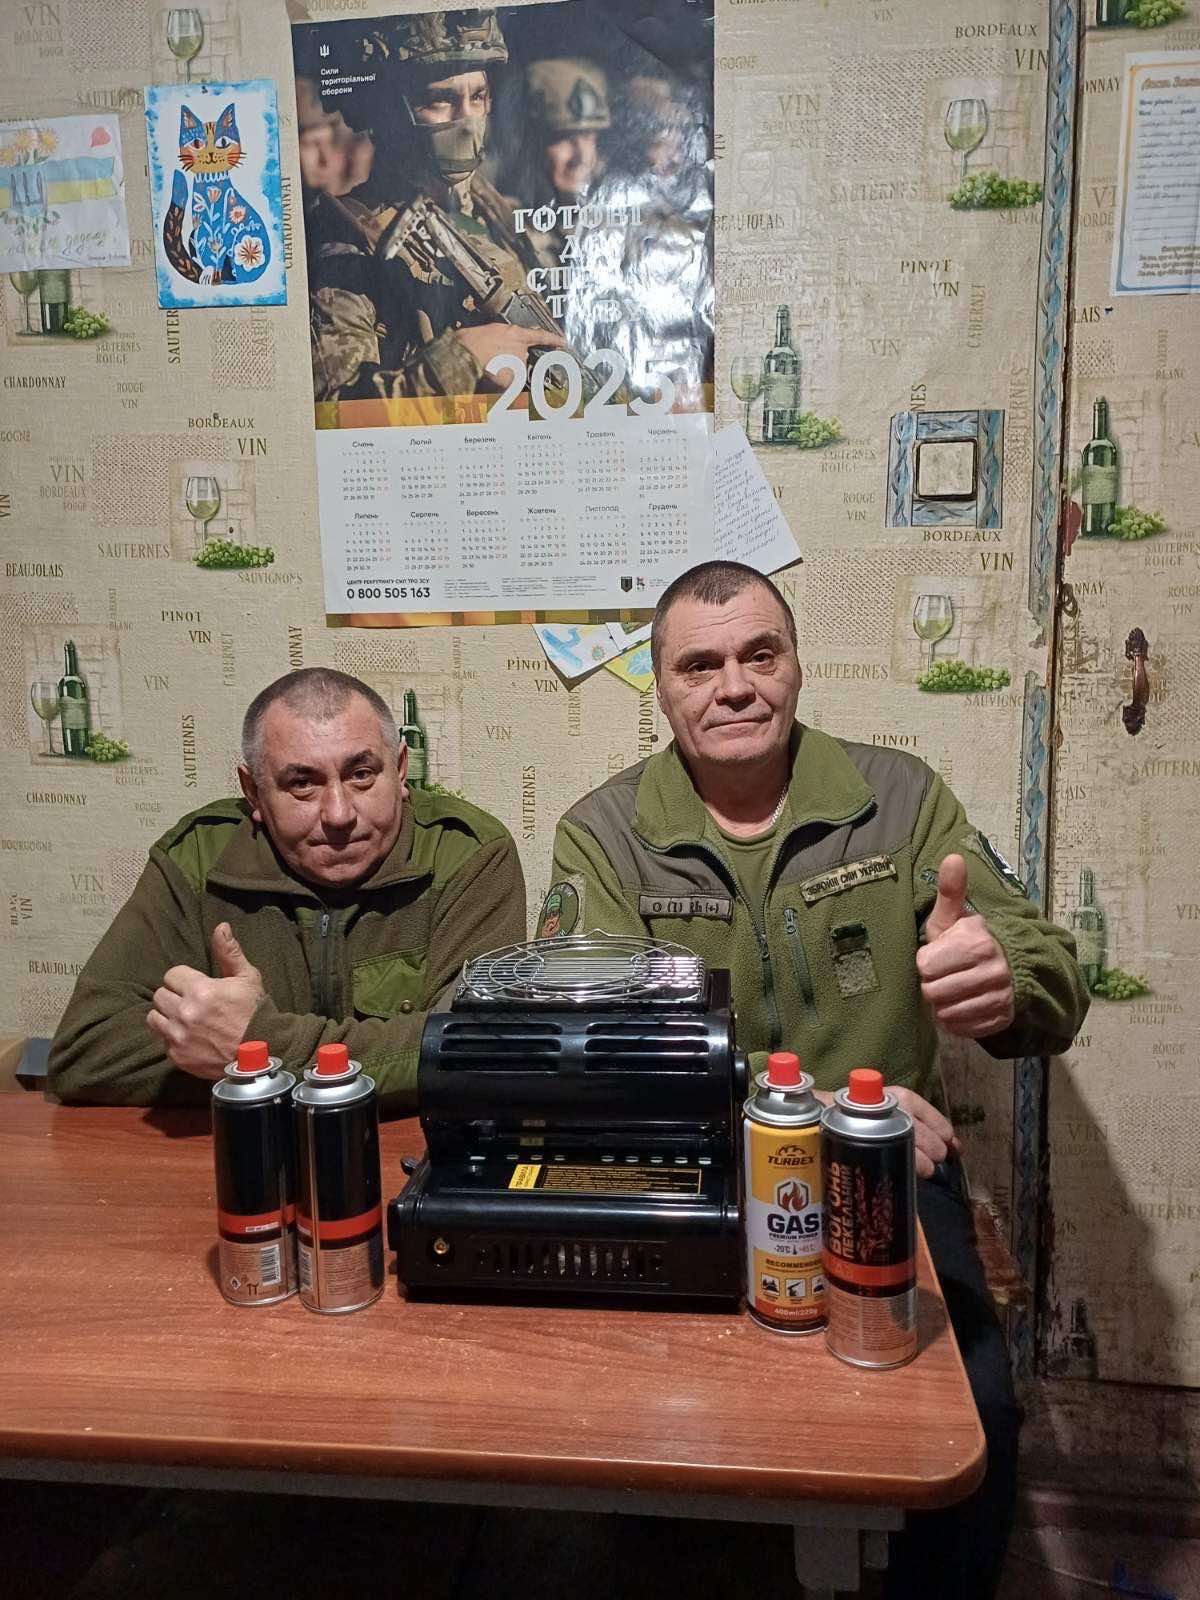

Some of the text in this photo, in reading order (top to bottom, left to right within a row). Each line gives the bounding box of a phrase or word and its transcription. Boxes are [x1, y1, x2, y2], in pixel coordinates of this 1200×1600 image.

[23, 5, 61, 26] VIN
[954, 22, 1038, 38] BORDEAUX
[1014, 48, 1049, 71] VIN
[320, 68, 340, 76] Сили
[321, 74, 377, 87] територіальної
[321, 86, 353, 96] оборони
[777, 93, 821, 116] VIN
[829, 182, 920, 202] SAUTERNES
[512, 203, 642, 234] ГОТОВІ
[932, 280, 960, 298] VIN
[966, 283, 985, 349] CABERNET
[95, 354, 128, 365] ROUGE
[3, 376, 67, 390] CHARDONNAY
[116, 382, 145, 394] ROUGE
[485, 347, 676, 420] 2025
[120, 399, 139, 410] VIN
[187, 416, 255, 430] BORDEAUX
[237, 437, 268, 457] VIN
[50, 464, 86, 484] VIN
[842, 491, 876, 504] ROUGE
[410, 510, 440, 519] Серпень
[466, 508, 499, 517] Вересень
[648, 502, 678, 513] Грудень
[846, 510, 867, 522] VIN
[922, 530, 1002, 543] BORDEAUX
[97, 543, 171, 560] SAUTERNES
[979, 552, 1015, 571] VIN
[1143, 555, 1185, 568] ROUGE
[5, 562, 65, 578] BEAUJOLAIS
[346, 588, 355, 599] 0
[358, 588, 381, 599] 800
[384, 587, 408, 598] 505
[410, 587, 430, 598] 163
[160, 609, 202, 623] PINOT
[1171, 604, 1193, 617] VIN
[188, 629, 212, 644] VIN
[804, 662, 889, 681] SAUTERNES
[143, 674, 170, 690] VIN
[534, 678, 559, 693] VIN
[485, 724, 513, 742] VIN
[871, 733, 920, 748] PINOT
[180, 713, 198, 789] SAUTERNES
[26, 791, 88, 807] CHARDONNAY
[521, 763, 537, 841] SAUTERNES
[138, 817, 157, 828] VIN
[69, 873, 105, 892] VIN
[20, 897, 33, 921] VIN
[28, 960, 84, 976] BEAUJOLAIS
[1156, 1059, 1177, 1072] VIN
[766, 1213, 820, 1235] GAS
[769, 1232, 797, 1240] PREMIUM
